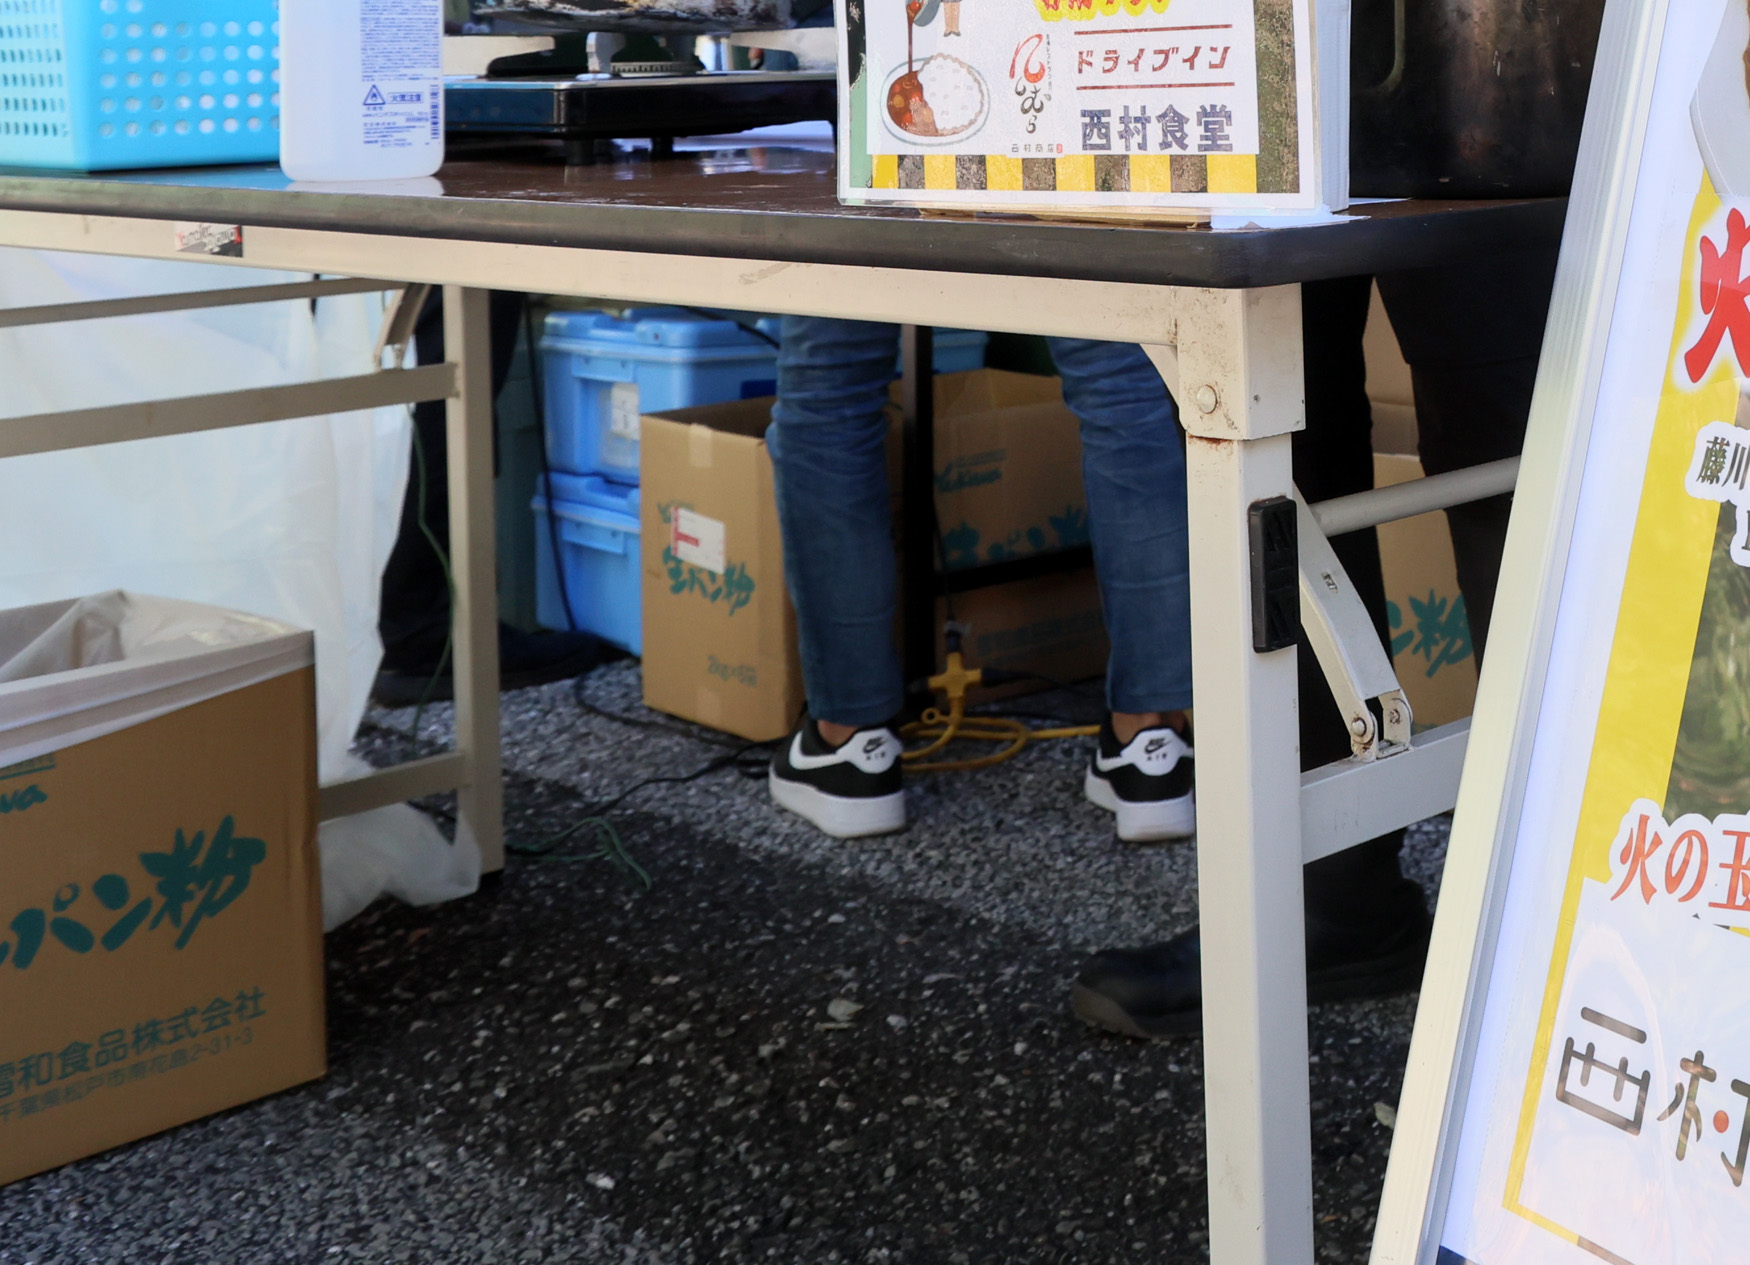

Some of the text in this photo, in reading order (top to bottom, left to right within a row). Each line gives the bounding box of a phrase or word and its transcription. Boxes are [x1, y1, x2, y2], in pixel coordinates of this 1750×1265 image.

[1077, 45, 1231, 74] ドライブイン
[1080, 103, 1234, 153] 西村食堂
